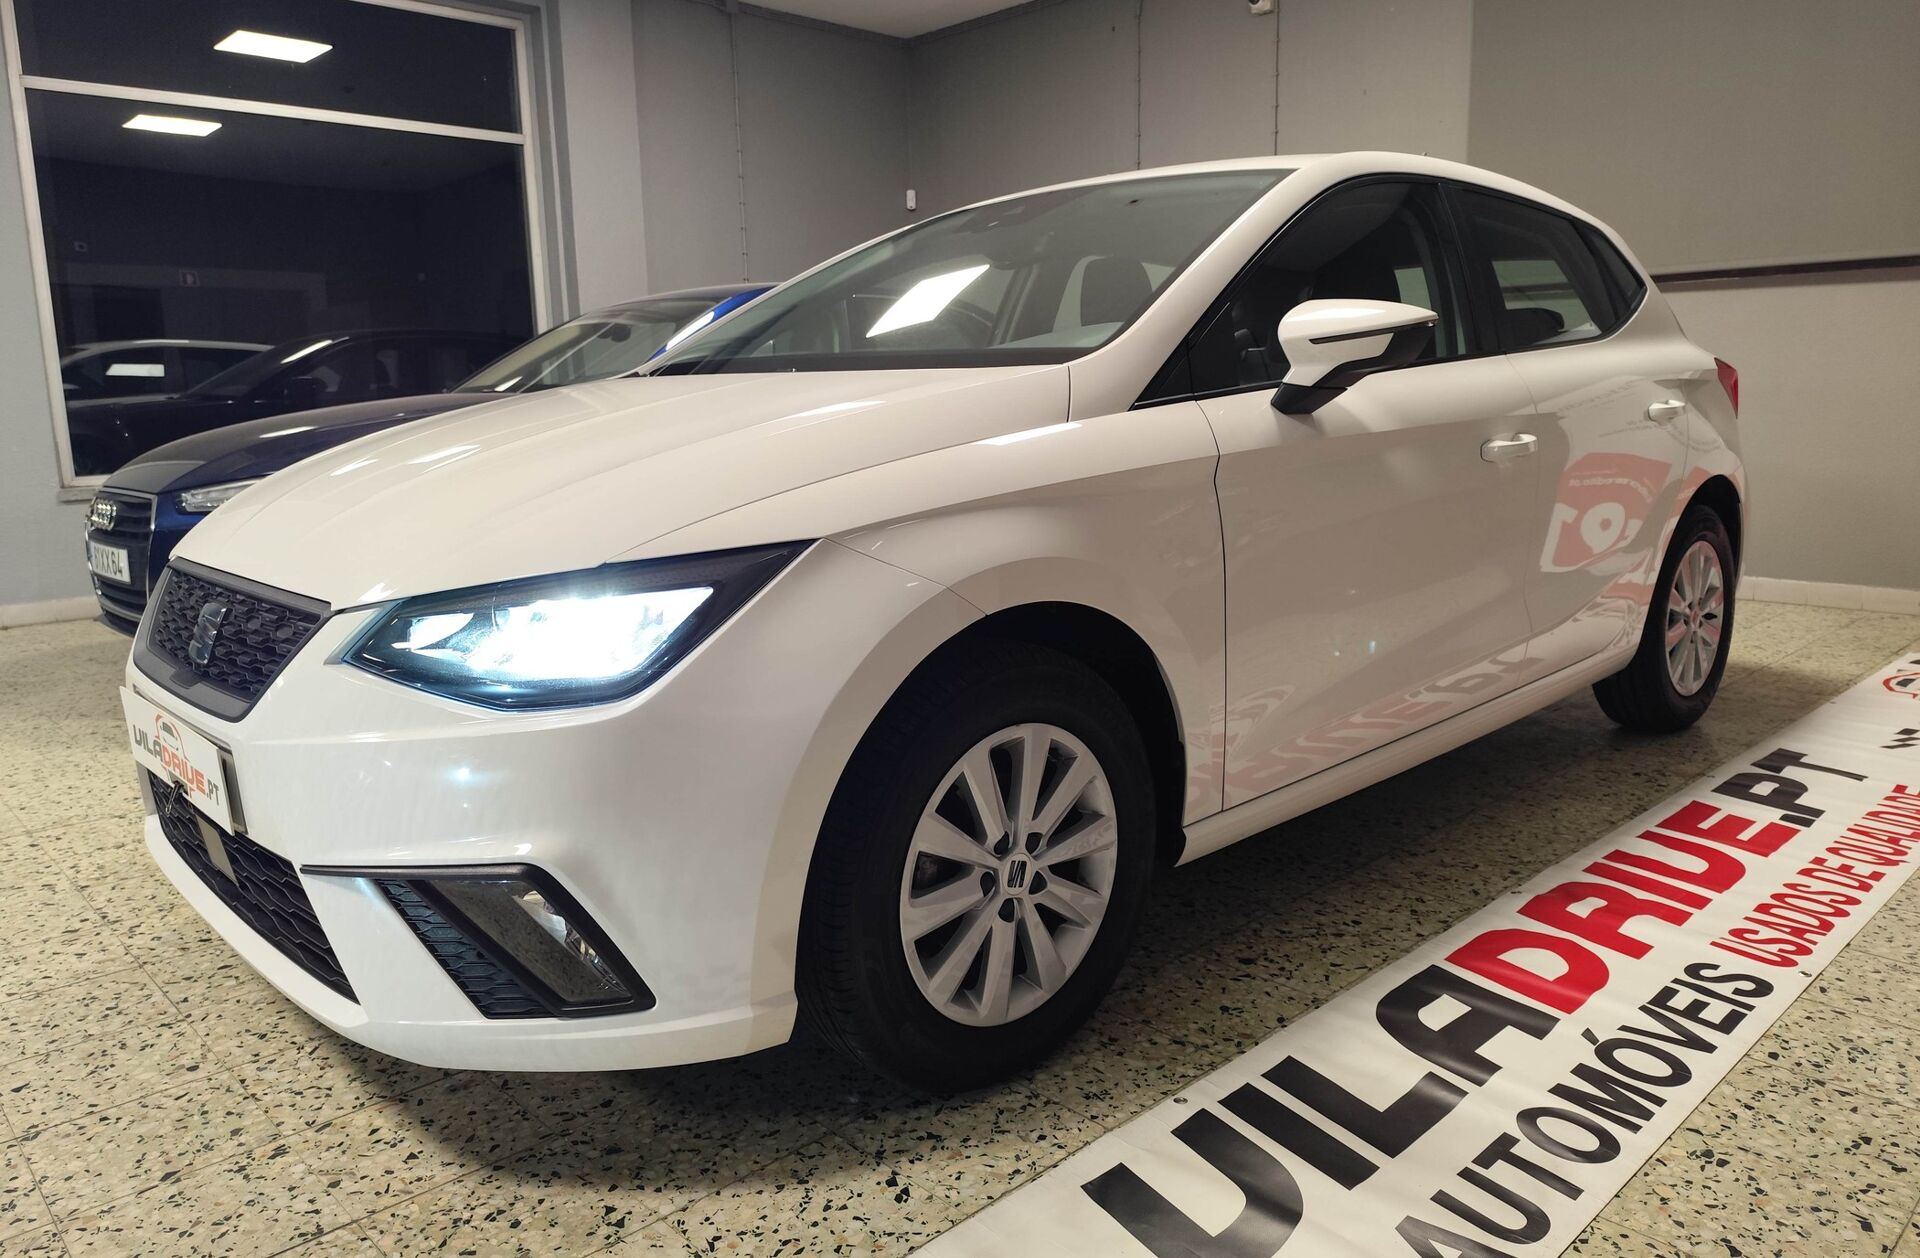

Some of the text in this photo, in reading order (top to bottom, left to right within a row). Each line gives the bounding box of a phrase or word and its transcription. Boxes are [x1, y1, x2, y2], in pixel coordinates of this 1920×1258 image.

[1395, 962, 1775, 1258] AUTOMÓVEIS
[1709, 883, 1863, 968] USADOS
[1796, 856, 1887, 893] DE
